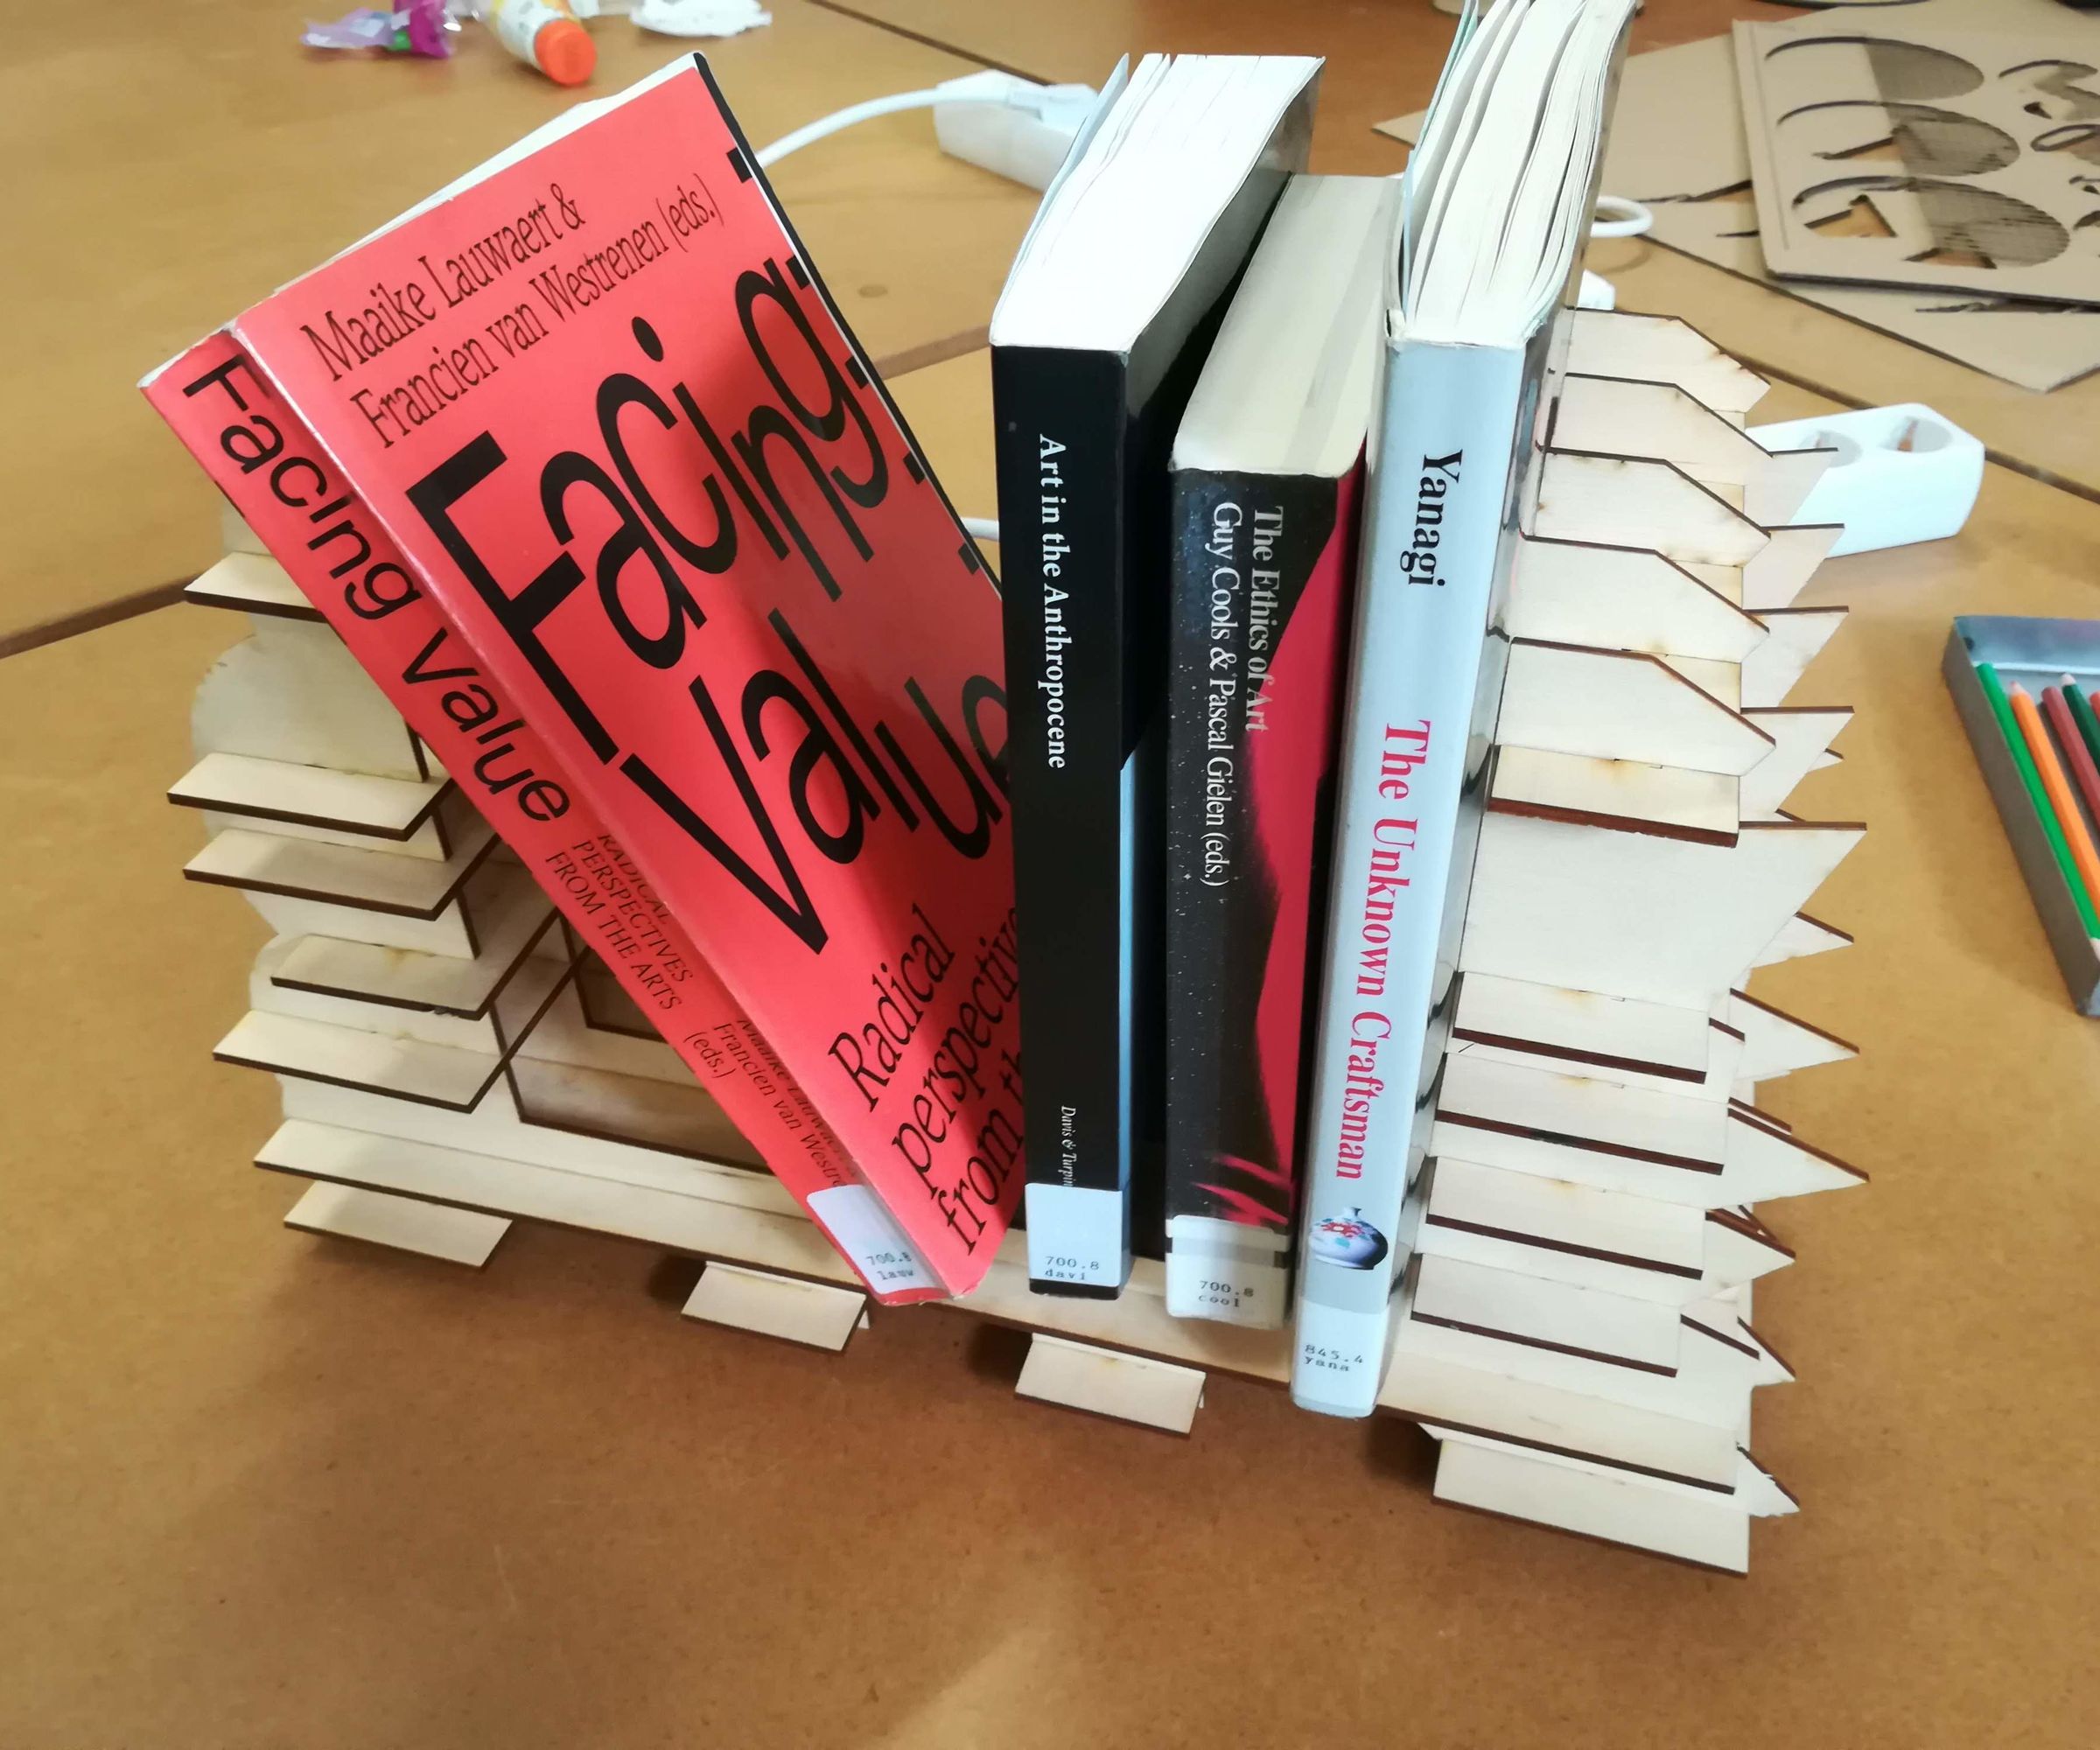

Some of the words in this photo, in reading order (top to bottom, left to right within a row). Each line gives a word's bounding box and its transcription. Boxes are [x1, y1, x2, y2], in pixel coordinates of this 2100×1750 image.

[301, 282, 436, 381] Maaike
[418, 199, 564, 309] Lauwaert
[551, 183, 585, 230] &
[351, 346, 499, 448] Francien
[486, 301, 550, 358] van
[528, 220, 669, 323] Westrenen
[656, 172, 724, 252] (eds.)
[1040, 434, 1067, 486] Art
[406, 257, 888, 764] Facing
[1042, 497, 1066, 525] in
[1205, 502, 1242, 560] Guy
[1252, 507, 1284, 561] The
[1400, 449, 1463, 586] Yanagi
[183, 354, 422, 620] Facing
[402, 628, 570, 822] Value
[1043, 531, 1070, 578] the
[1210, 567, 1241, 640] Cools
[1250, 569, 1281, 650] Ethics
[1039, 583, 1072, 769] Anthropocene
[1209, 648, 1236, 669] &
[1248, 655, 1273, 685] of
[1207, 677, 1237, 750] Pascal
[1246, 687, 1273, 732] Art
[1205, 754, 1235, 827] Gielen
[1377, 719, 1431, 801] The
[1200, 832, 1231, 886] (eds.)
[545, 851, 606, 915] FROM
[598, 914, 638, 960] THE
[631, 962, 682, 1010] ARTS
[572, 839, 693, 983] PERSPECTIVES
[1356, 817, 1419, 997] Unknown
[829, 903, 956, 1112] Radical
[682, 1032, 736, 1079] (eds.)
[714, 1023, 776, 1096] Francien
[774, 1100, 802, 1130] van
[892, 907, 1018, 1200] perspectiv
[1335, 1011, 1393, 1180] Craftsman
[938, 1109, 1024, 1256] from
[1045, 1268, 1085, 1280] davi
[1046, 1256, 1100, 1270] 700.8
[1200, 1280, 1254, 1298] 700.8
[1305, 1344, 1362, 1363] 845.4
